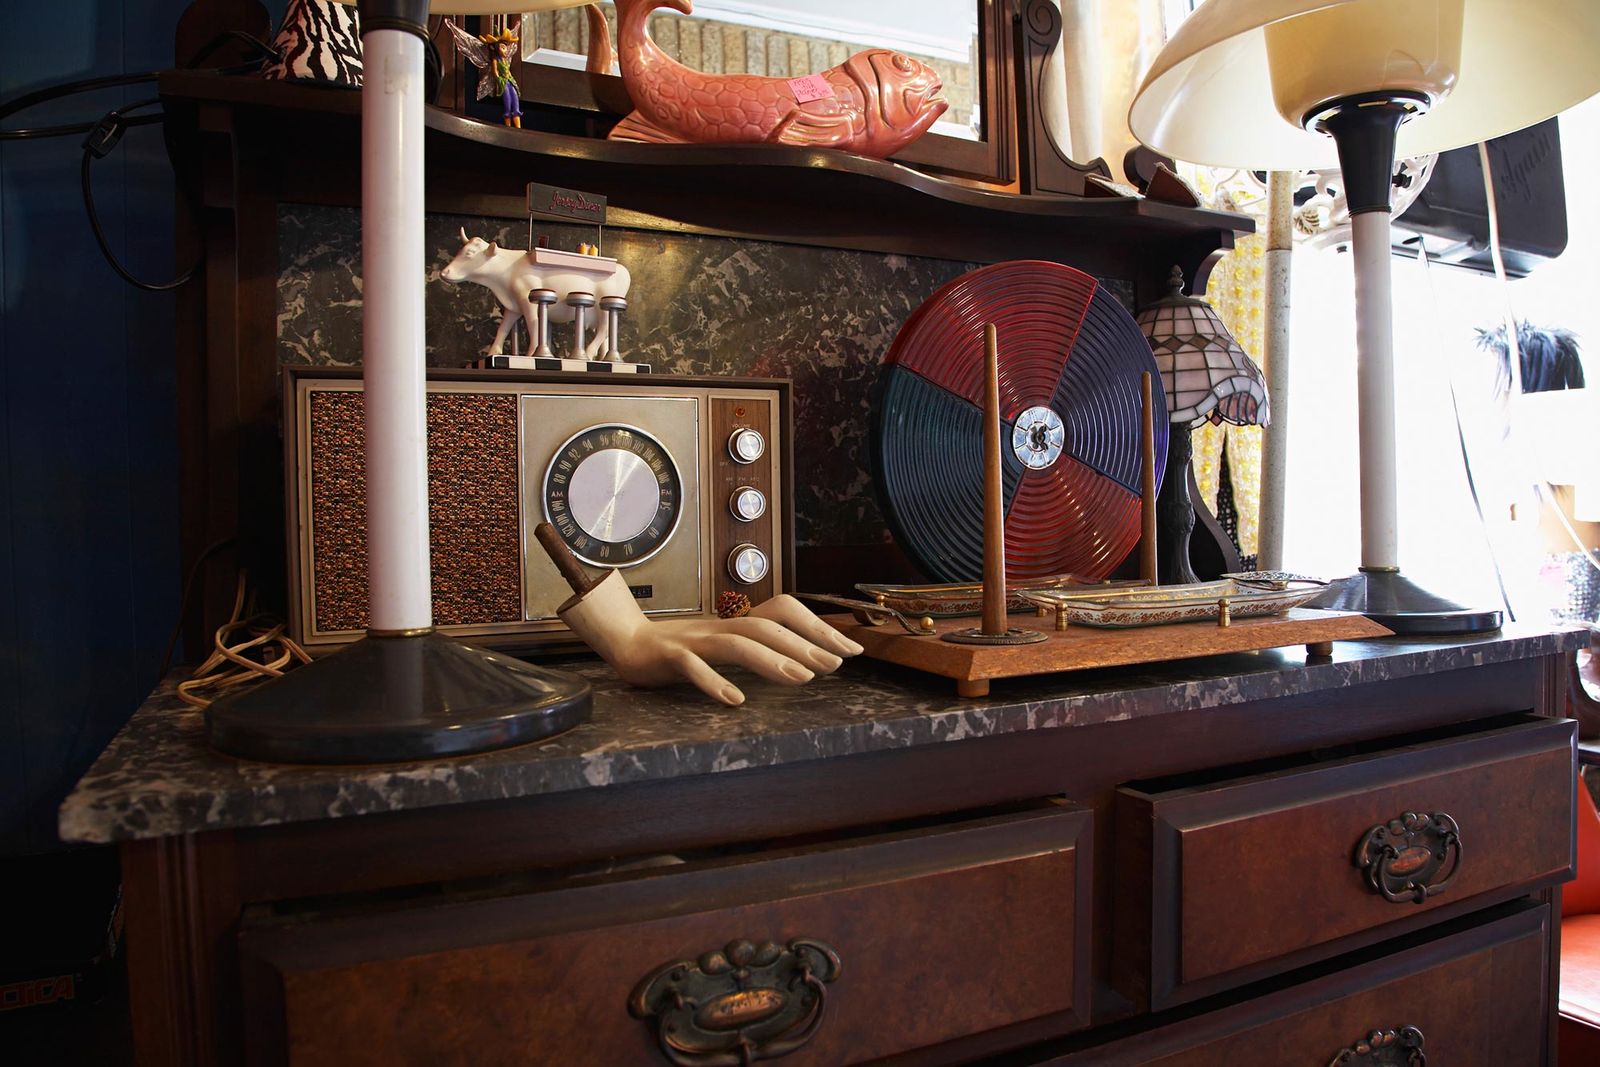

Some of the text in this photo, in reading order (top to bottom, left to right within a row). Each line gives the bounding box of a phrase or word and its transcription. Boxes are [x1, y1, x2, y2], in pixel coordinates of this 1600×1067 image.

[582, 439, 594, 451] 94
[600, 435, 608, 446] 96
[633, 441, 644, 453] 102
[569, 449, 580, 461] 92
[644, 448, 655, 461] 104
[559, 461, 572, 471] 90
[553, 474, 566, 483] 88
[562, 524, 575, 537] 120
[574, 535, 587, 549] 100
[600, 546, 609, 557] 80
[624, 544, 632, 555] 70
